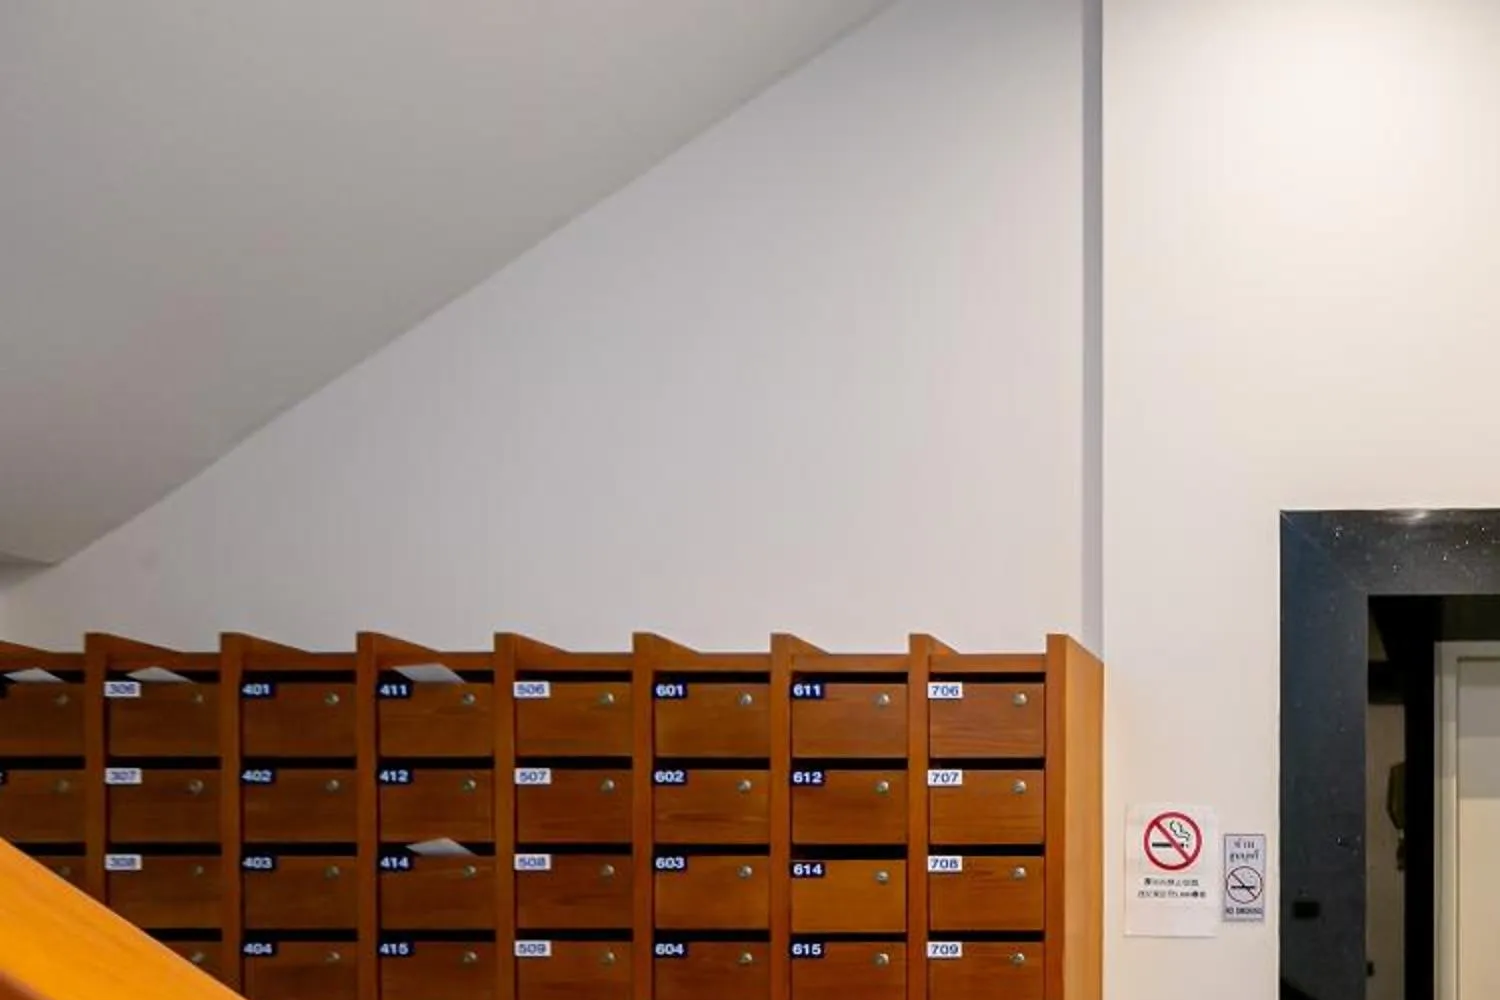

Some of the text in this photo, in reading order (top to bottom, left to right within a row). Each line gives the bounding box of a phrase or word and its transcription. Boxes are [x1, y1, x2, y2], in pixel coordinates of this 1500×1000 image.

[243, 683, 271, 696] 401
[380, 683, 408, 695] 411
[517, 683, 546, 696] 506
[655, 684, 684, 697] 601
[793, 683, 822, 697] 611
[931, 685, 959, 697] 706
[242, 770, 272, 782] 402
[380, 769, 409, 782] 412
[518, 770, 547, 783] 507
[654, 770, 685, 783] 602
[792, 771, 823, 784] 612
[931, 771, 959, 783] 707
[243, 856, 272, 869] 403
[380, 856, 409, 869] 414
[517, 856, 546, 868] 508
[655, 856, 685, 869] 603
[930, 857, 959, 870] 708
[793, 863, 823, 876] 614
[243, 942, 272, 955] 404
[380, 943, 409, 955] 415
[518, 942, 547, 955] 509
[655, 943, 684, 955] 604
[791, 943, 822, 956] 615
[930, 943, 959, 955] 709
